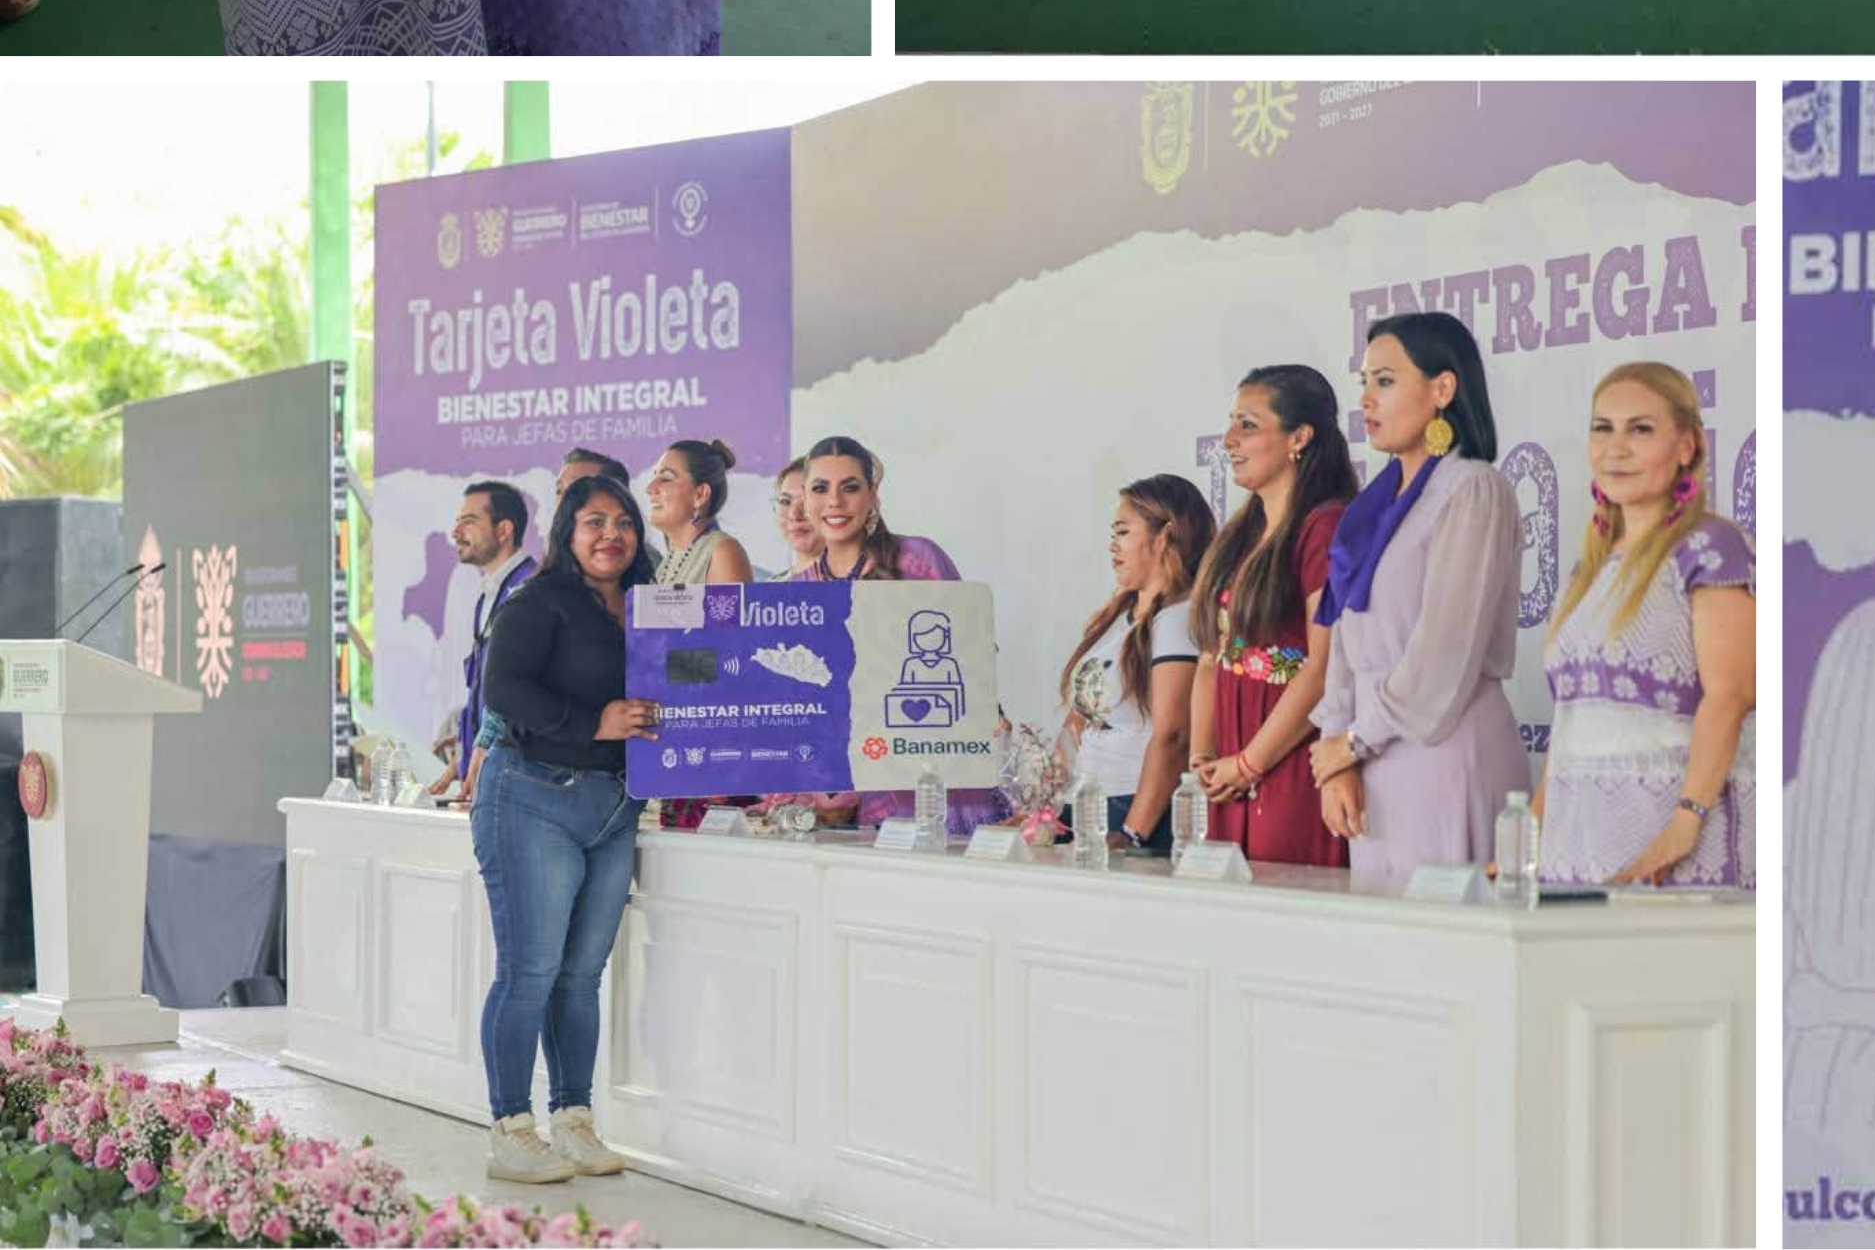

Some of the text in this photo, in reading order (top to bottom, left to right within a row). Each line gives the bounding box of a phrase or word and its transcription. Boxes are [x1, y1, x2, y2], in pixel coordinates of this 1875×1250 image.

[408, 268, 740, 391] Tarjeta Violeta
[437, 376, 708, 424] BIENESTAR INTEGRAL
[461, 413, 678, 449] PARA JEFAS DE FAMILIA
[657, 702, 827, 719] IENESTAR INTEGRAL
[665, 716, 810, 729] PARA JEFAS DE FAMILIA
[893, 736, 991, 756] Banamex
